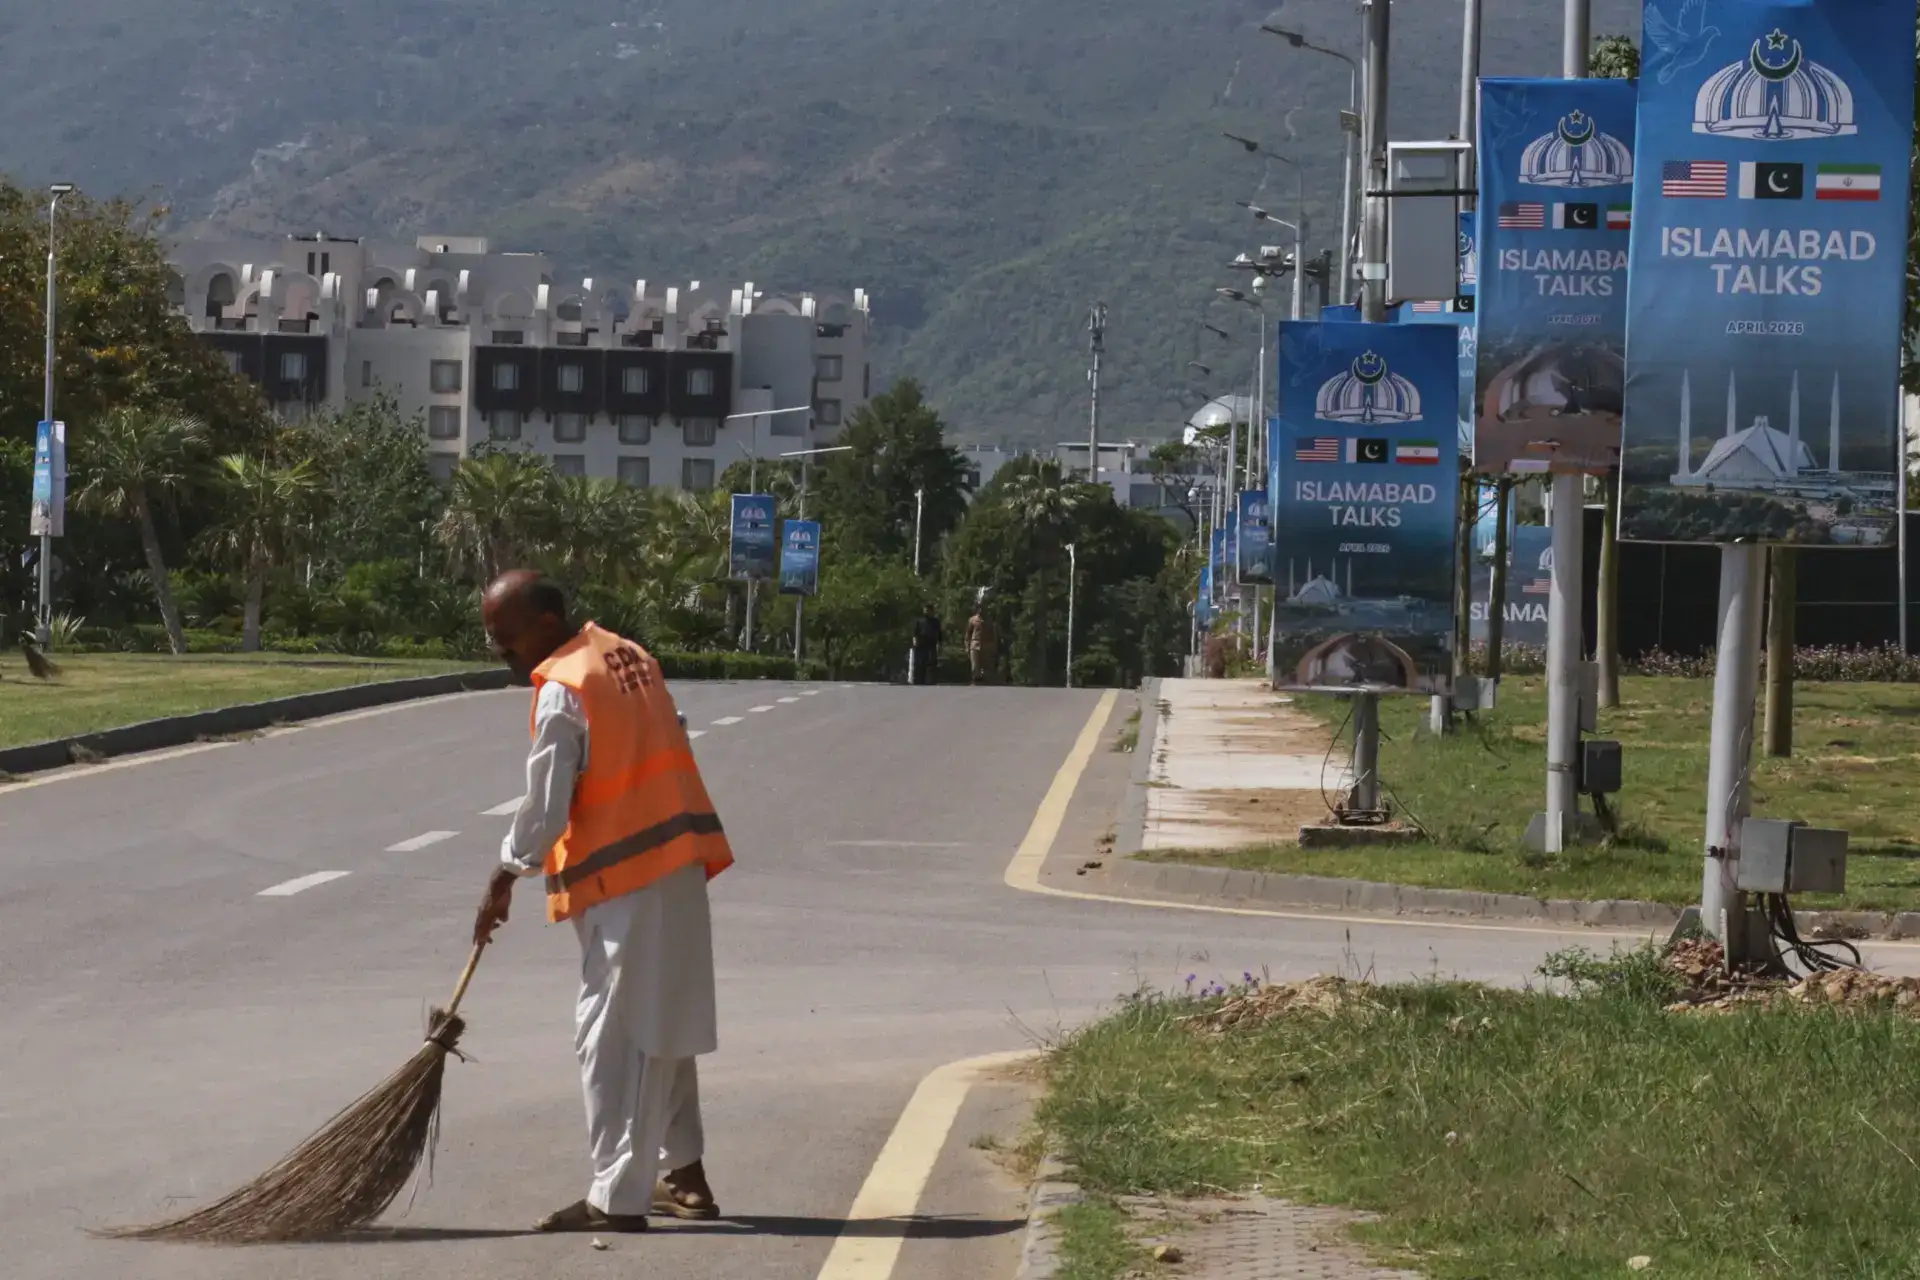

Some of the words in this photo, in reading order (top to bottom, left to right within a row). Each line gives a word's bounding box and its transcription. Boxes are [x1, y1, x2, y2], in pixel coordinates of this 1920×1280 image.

[1661, 227, 1877, 261] ISLAMABAD
[1498, 248, 1630, 272] ISLAMABA
[1535, 274, 1613, 297] TALKS
[1710, 264, 1822, 297] TALKS
[1725, 320, 1767, 335] APRIL
[1768, 321, 1804, 336] 2026
[1295, 480, 1437, 504] ISLAMABAD
[1328, 505, 1402, 527] TALKS
